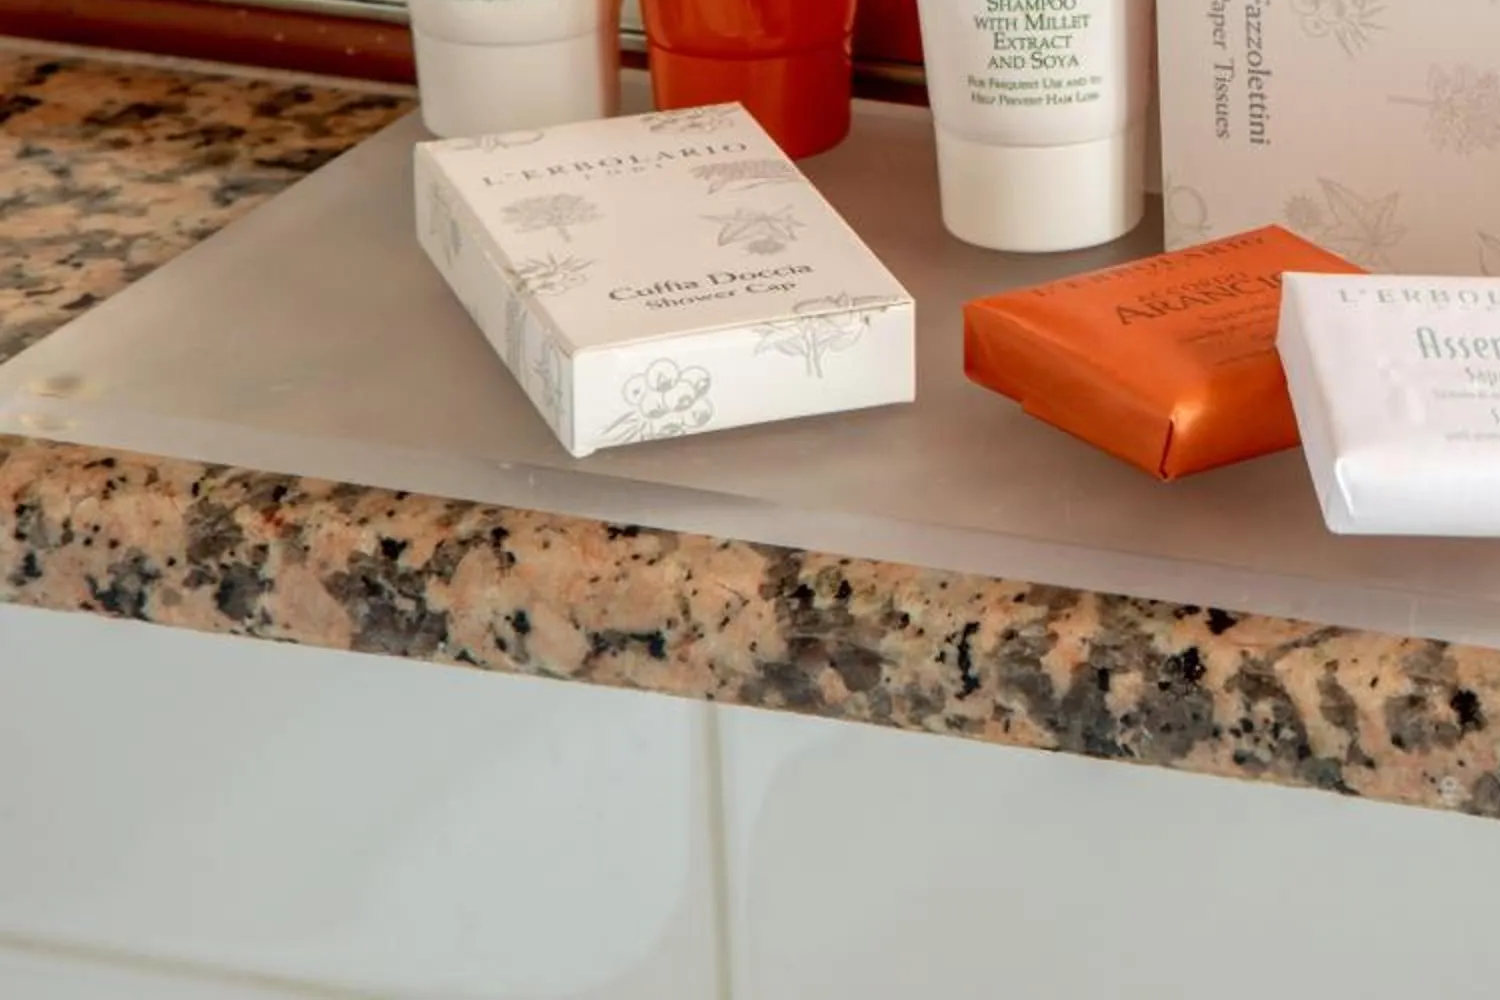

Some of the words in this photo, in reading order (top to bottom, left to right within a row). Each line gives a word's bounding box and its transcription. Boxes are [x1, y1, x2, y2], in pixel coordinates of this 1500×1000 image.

[974, 15, 1017, 31] WITH
[1024, 13, 1092, 31] MILLET
[993, 32, 1072, 51] EXTRACT
[987, 55, 1025, 70] AND
[1031, 52, 1080, 70] SOYA
[1213, 56, 1236, 141] Tissues
[481, 140, 750, 187] L'ERBOLARIO
[607, 277, 699, 304] Cuffia
[706, 261, 815, 288] Doccia
[645, 289, 737, 312] Shower
[744, 278, 799, 302] Cap
